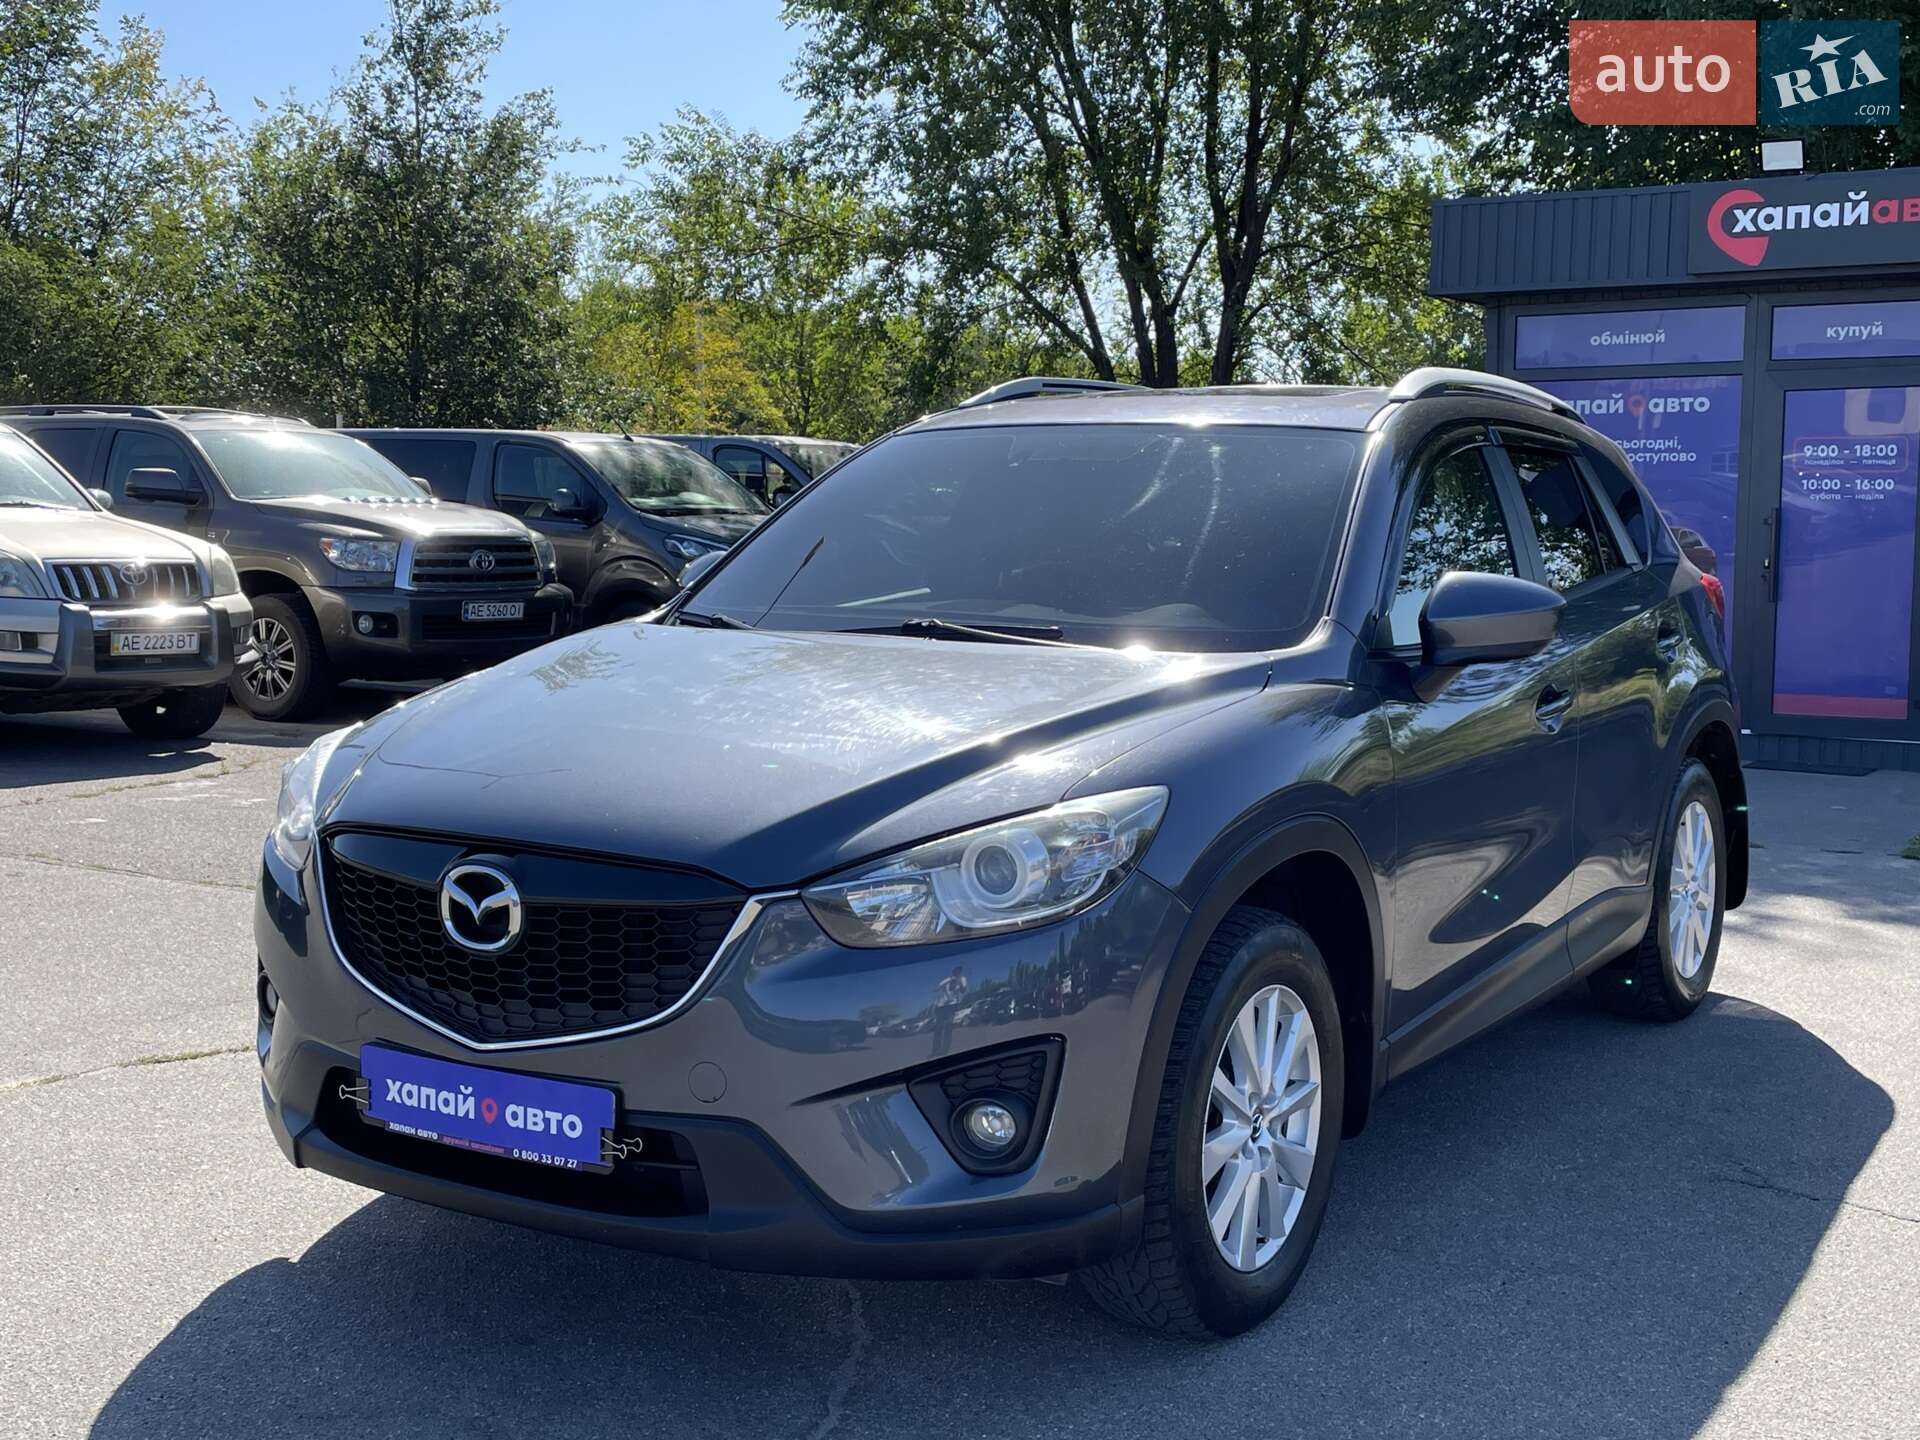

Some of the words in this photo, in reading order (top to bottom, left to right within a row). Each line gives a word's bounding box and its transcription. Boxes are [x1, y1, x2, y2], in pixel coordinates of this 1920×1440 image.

[1590, 329, 1666, 346] обмінюй
[1826, 320, 1883, 341] купуй
[1563, 393, 1624, 415] пай
[1648, 396, 1711, 413] авто
[1628, 452, 1697, 465] оступово
[1803, 445, 1839, 457] 9:00
[1854, 444, 1898, 457] 18:00
[1802, 479, 1840, 490] 10:00
[1855, 479, 1895, 490] 16:00
[1810, 492, 1841, 502] субота
[471, 604, 485, 617] AE
[486, 604, 508, 617] 5260
[121, 636, 140, 651] AE
[143, 635, 175, 651] 2223
[176, 633, 196, 649] BT
[386, 1078, 475, 1120] хапай
[505, 1103, 583, 1139] авто
[513, 1148, 520, 1158] 0
[522, 1150, 540, 1162] 800
[541, 1153, 552, 1165] 33
[554, 1156, 566, 1167] 07
[567, 1158, 578, 1169] 27
